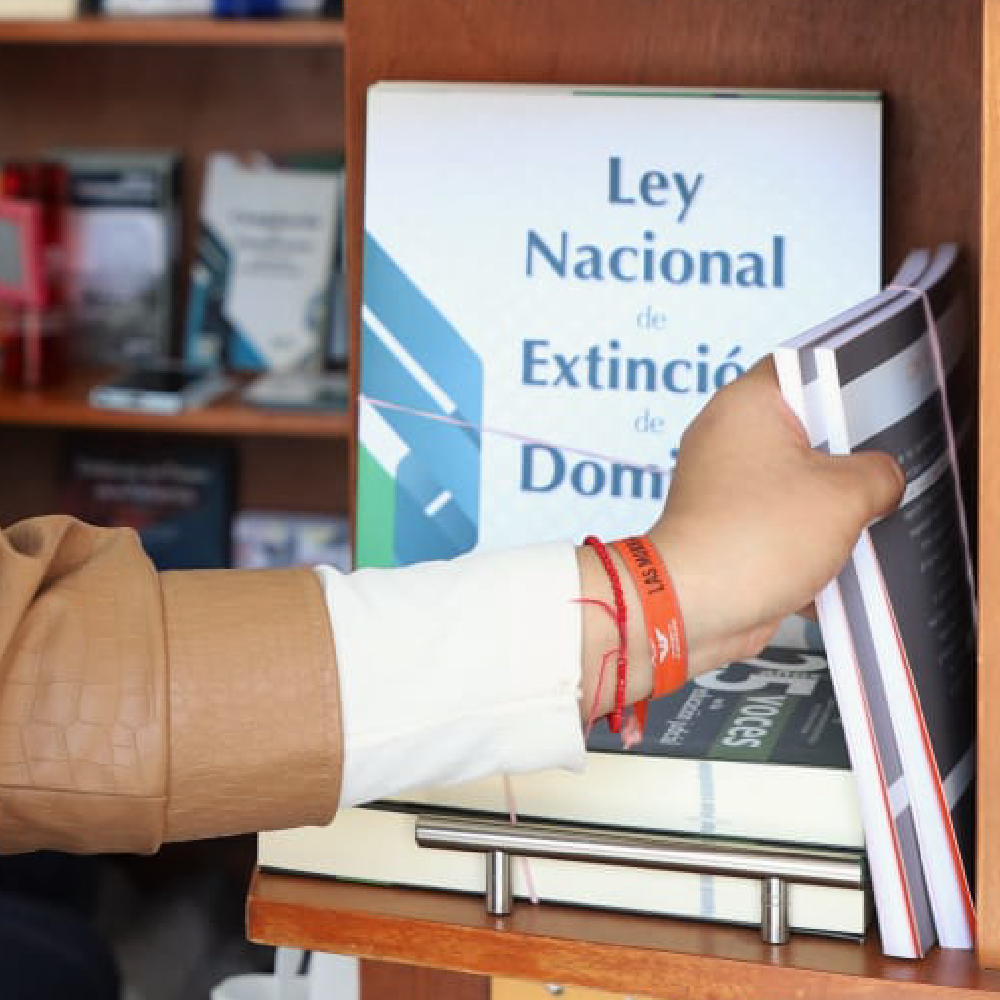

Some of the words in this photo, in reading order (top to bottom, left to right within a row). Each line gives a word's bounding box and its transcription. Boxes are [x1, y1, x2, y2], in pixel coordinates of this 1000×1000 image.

[607, 156, 704, 223] Ley
[525, 229, 785, 289] Nacional
[636, 305, 667, 329] de
[521, 338, 746, 394] Extinció
[634, 409, 666, 433] de
